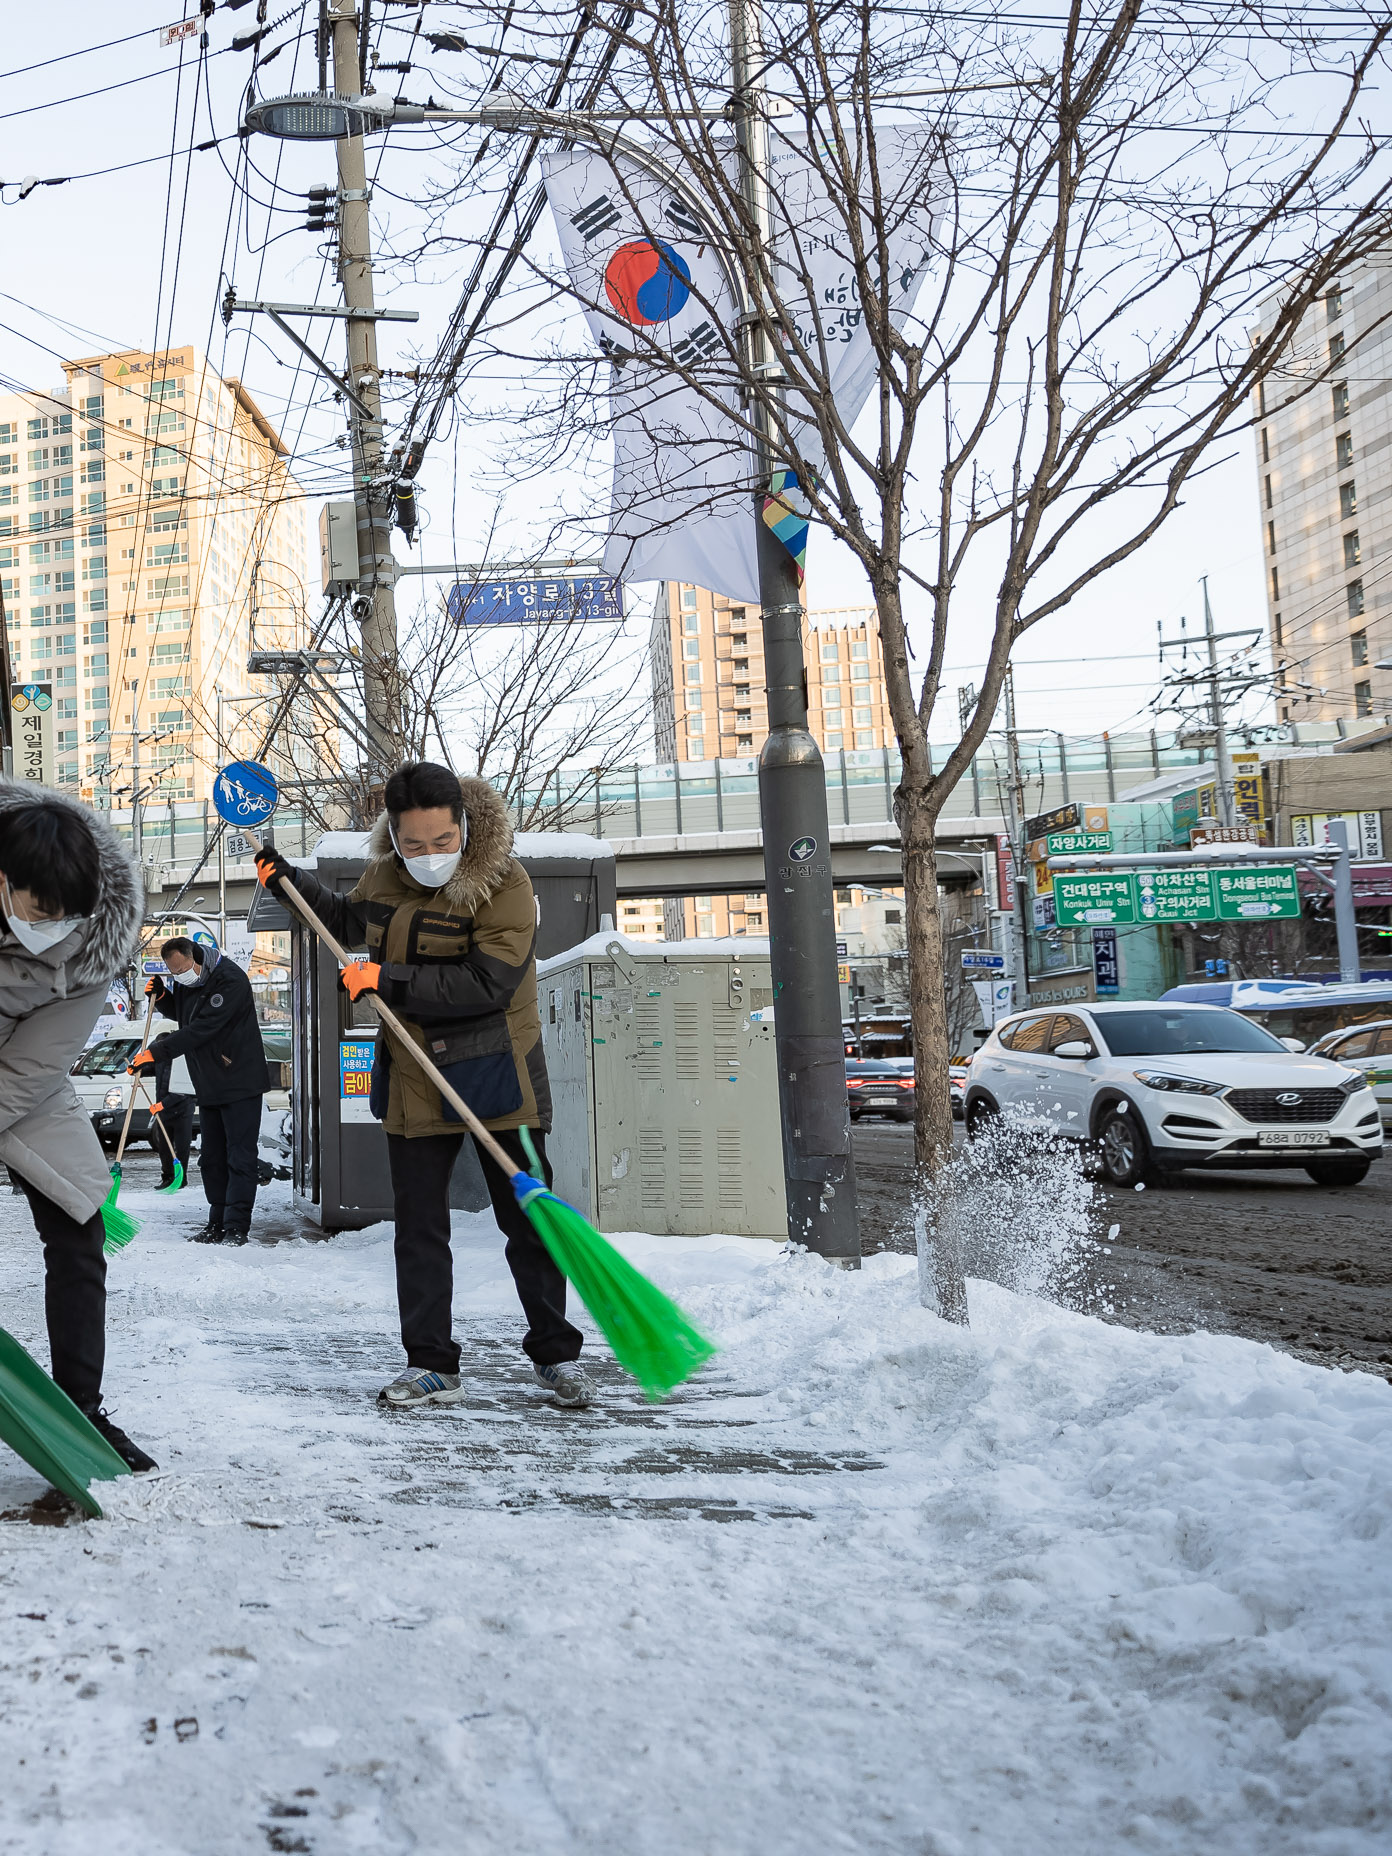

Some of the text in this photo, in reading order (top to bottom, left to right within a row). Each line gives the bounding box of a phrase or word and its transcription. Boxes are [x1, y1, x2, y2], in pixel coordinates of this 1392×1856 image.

[22, 715, 43, 783] 제일경희
[1051, 834, 1110, 850] 자양사거리
[778, 864, 827, 879] 광진구
[1155, 872, 1209, 886] 아차산역
[1061, 881, 1128, 897] 건대입구역
[1219, 875, 1293, 891] 동서울터미널
[1155, 895, 1211, 909] 구의사거리
[1095, 941, 1116, 978] 치과
[343, 1059, 368, 1070] 사용하고
[1294, 1133, 1324, 1144] 0792
